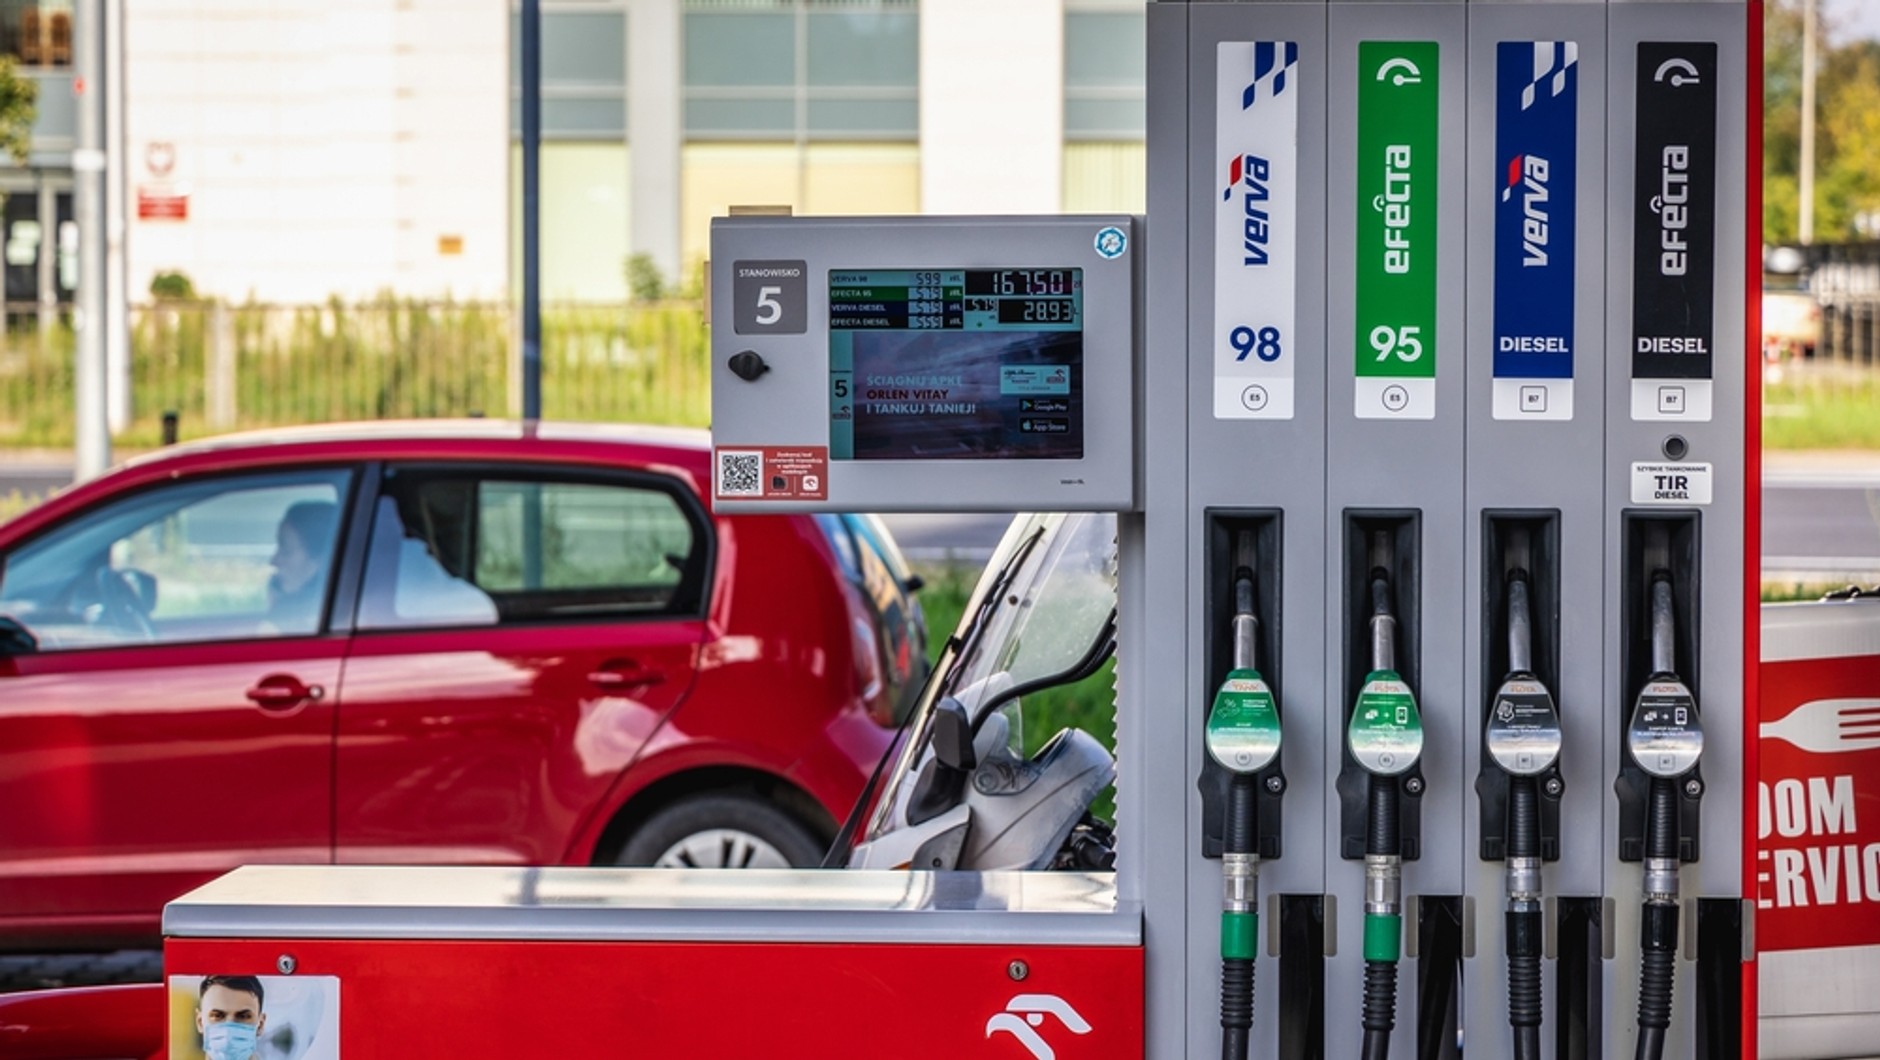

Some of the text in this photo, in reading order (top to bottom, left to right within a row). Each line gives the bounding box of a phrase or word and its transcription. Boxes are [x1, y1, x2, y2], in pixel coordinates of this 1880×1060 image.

[1244, 155, 1270, 266] verva
[1522, 155, 1549, 267] verva
[739, 269, 800, 278] STANOWISKO
[831, 289, 861, 298] EFECTA
[755, 286, 782, 325] 5
[831, 318, 861, 326] EFECTA
[863, 318, 890, 326] DIESEL
[1229, 326, 1281, 362] 98
[1370, 325, 1422, 362] 95
[1500, 337, 1569, 352] DIESEL
[1638, 338, 1707, 353] DIESEL
[834, 379, 848, 398] 5
[866, 389, 949, 400] ORLEN VITAY
[1528, 394, 1539, 403] B7
[1666, 396, 1677, 404] B7
[874, 403, 925, 414] TANKUJ
[929, 403, 976, 414] TANIEJ!
[1654, 475, 1688, 490] TIR
[1654, 491, 1689, 499] DIESEL
